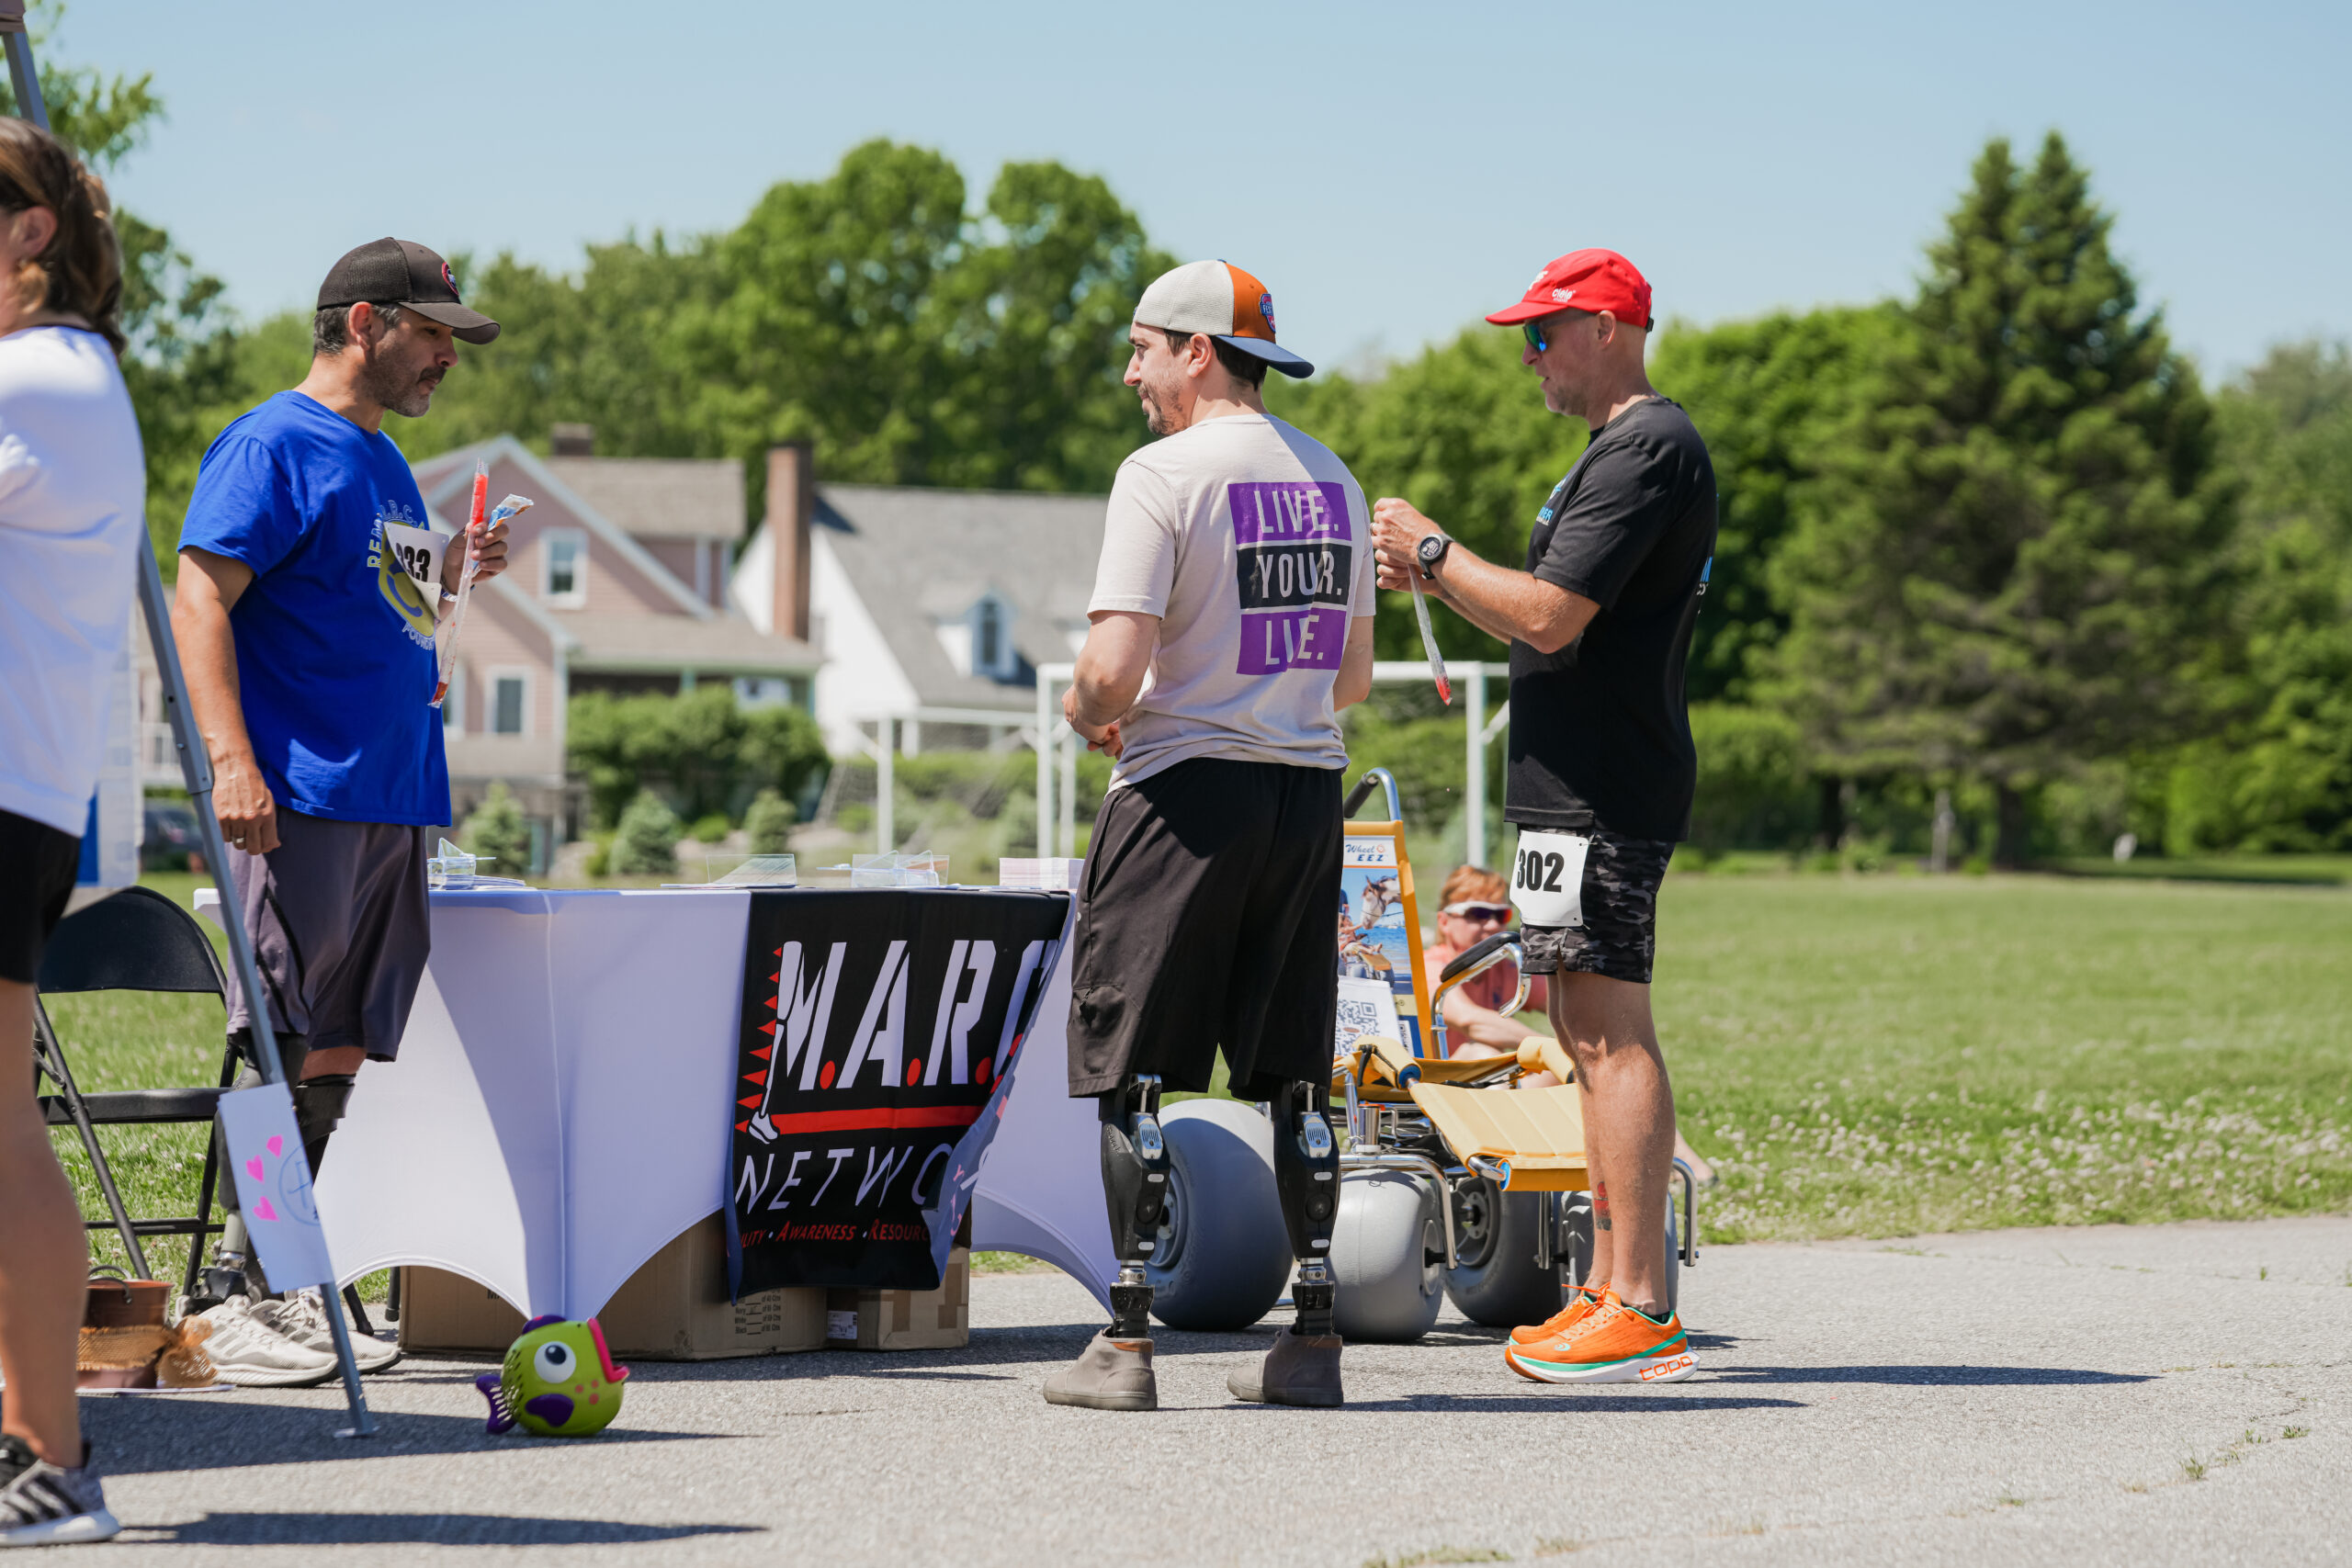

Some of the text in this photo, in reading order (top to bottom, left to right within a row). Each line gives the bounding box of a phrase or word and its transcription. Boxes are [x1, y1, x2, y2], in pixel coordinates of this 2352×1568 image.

[1254, 490, 1339, 534] LIVE.
[1256, 551, 1342, 599] YOUR.
[1345, 843, 1375, 853] Wheel
[1517, 848, 1565, 893] 302
[775, 1220, 856, 1242] AWARENESS
